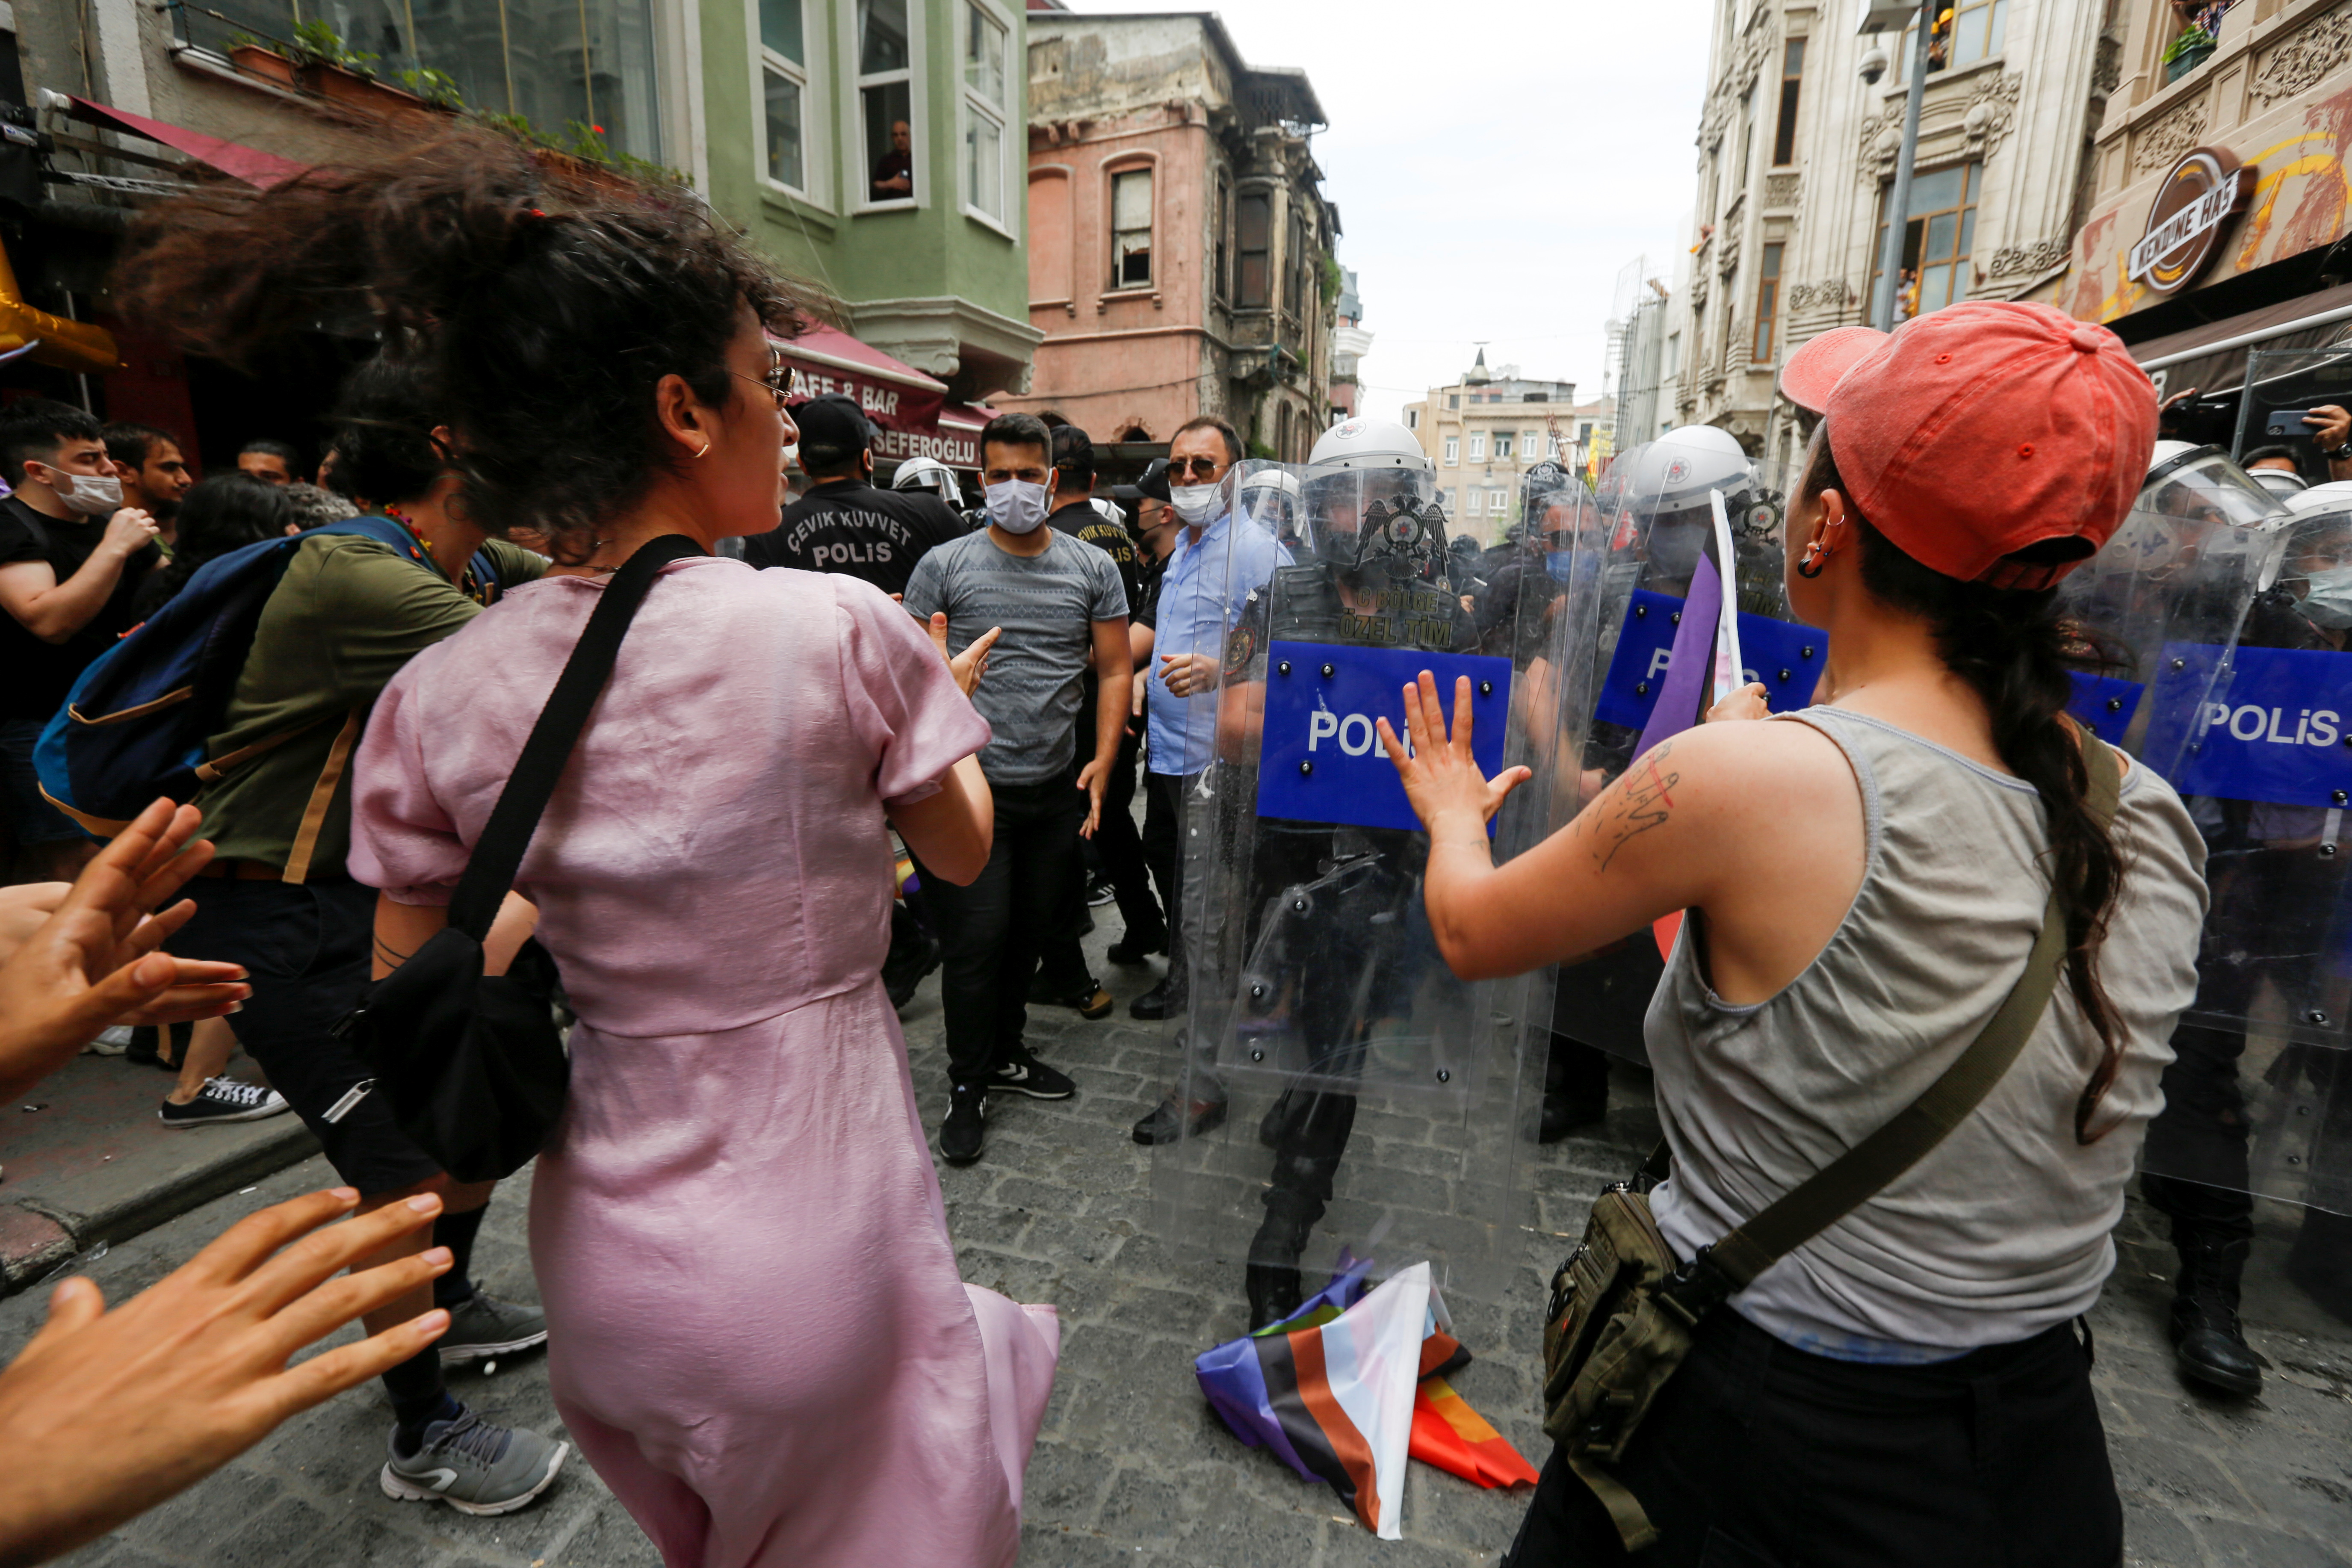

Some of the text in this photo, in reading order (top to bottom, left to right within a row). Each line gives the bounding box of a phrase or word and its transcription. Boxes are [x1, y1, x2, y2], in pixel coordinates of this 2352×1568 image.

[776, 368, 834, 399] AFE
[862, 386, 898, 415] BAR
[874, 431, 975, 463] SEFEROĞLU
[839, 511, 911, 546] KUVVET
[1357, 585, 1439, 613] C BÖLGE
[1339, 607, 1397, 642] ÖZEL
